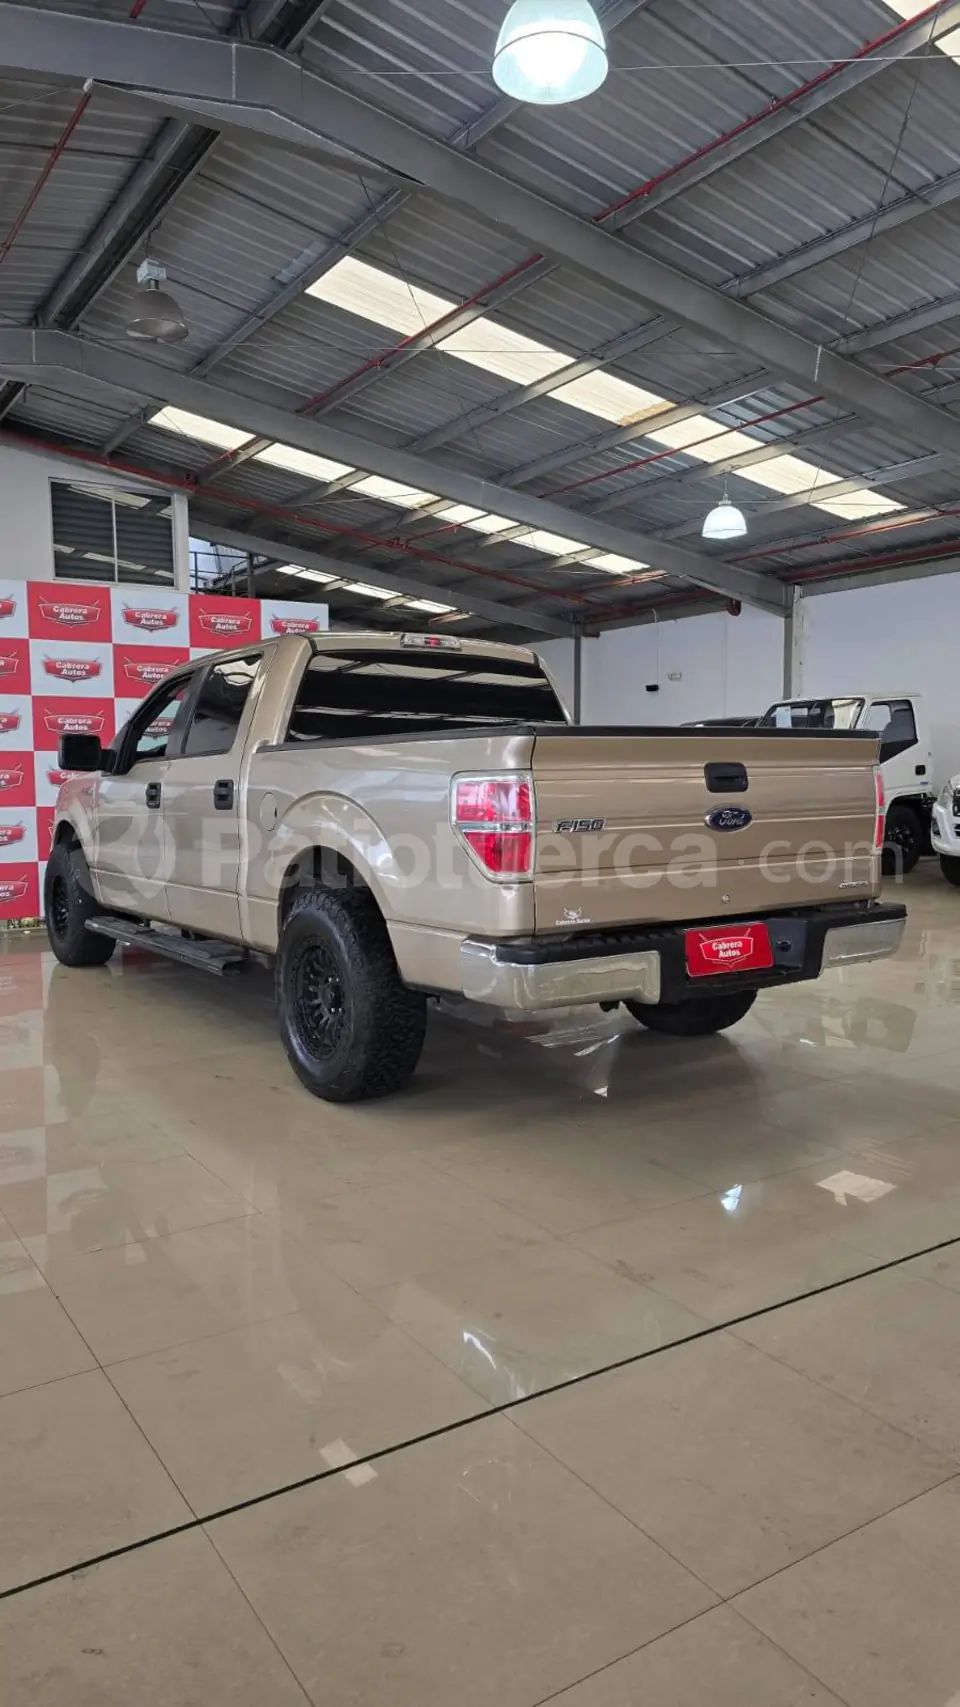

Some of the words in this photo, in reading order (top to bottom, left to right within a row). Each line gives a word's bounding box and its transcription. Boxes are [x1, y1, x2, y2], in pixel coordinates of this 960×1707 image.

[52, 605, 88, 615] Cabrera
[58, 613, 85, 621] Autos
[135, 611, 167, 620] Cabrera
[140, 618, 164, 626] Autos
[210, 616, 241, 625] Cabrera
[281, 621, 310, 630] Cabrera
[55, 661, 90, 670] Cabrera
[136, 665, 169, 673] Cabrera
[60, 668, 86, 676] Autos
[57, 717, 92, 725] Cabrera
[63, 723, 88, 731] Autos
[719, 810, 746, 826] Ford
[712, 940, 743, 951] Cabrera
[718, 948, 741, 958] Autos
